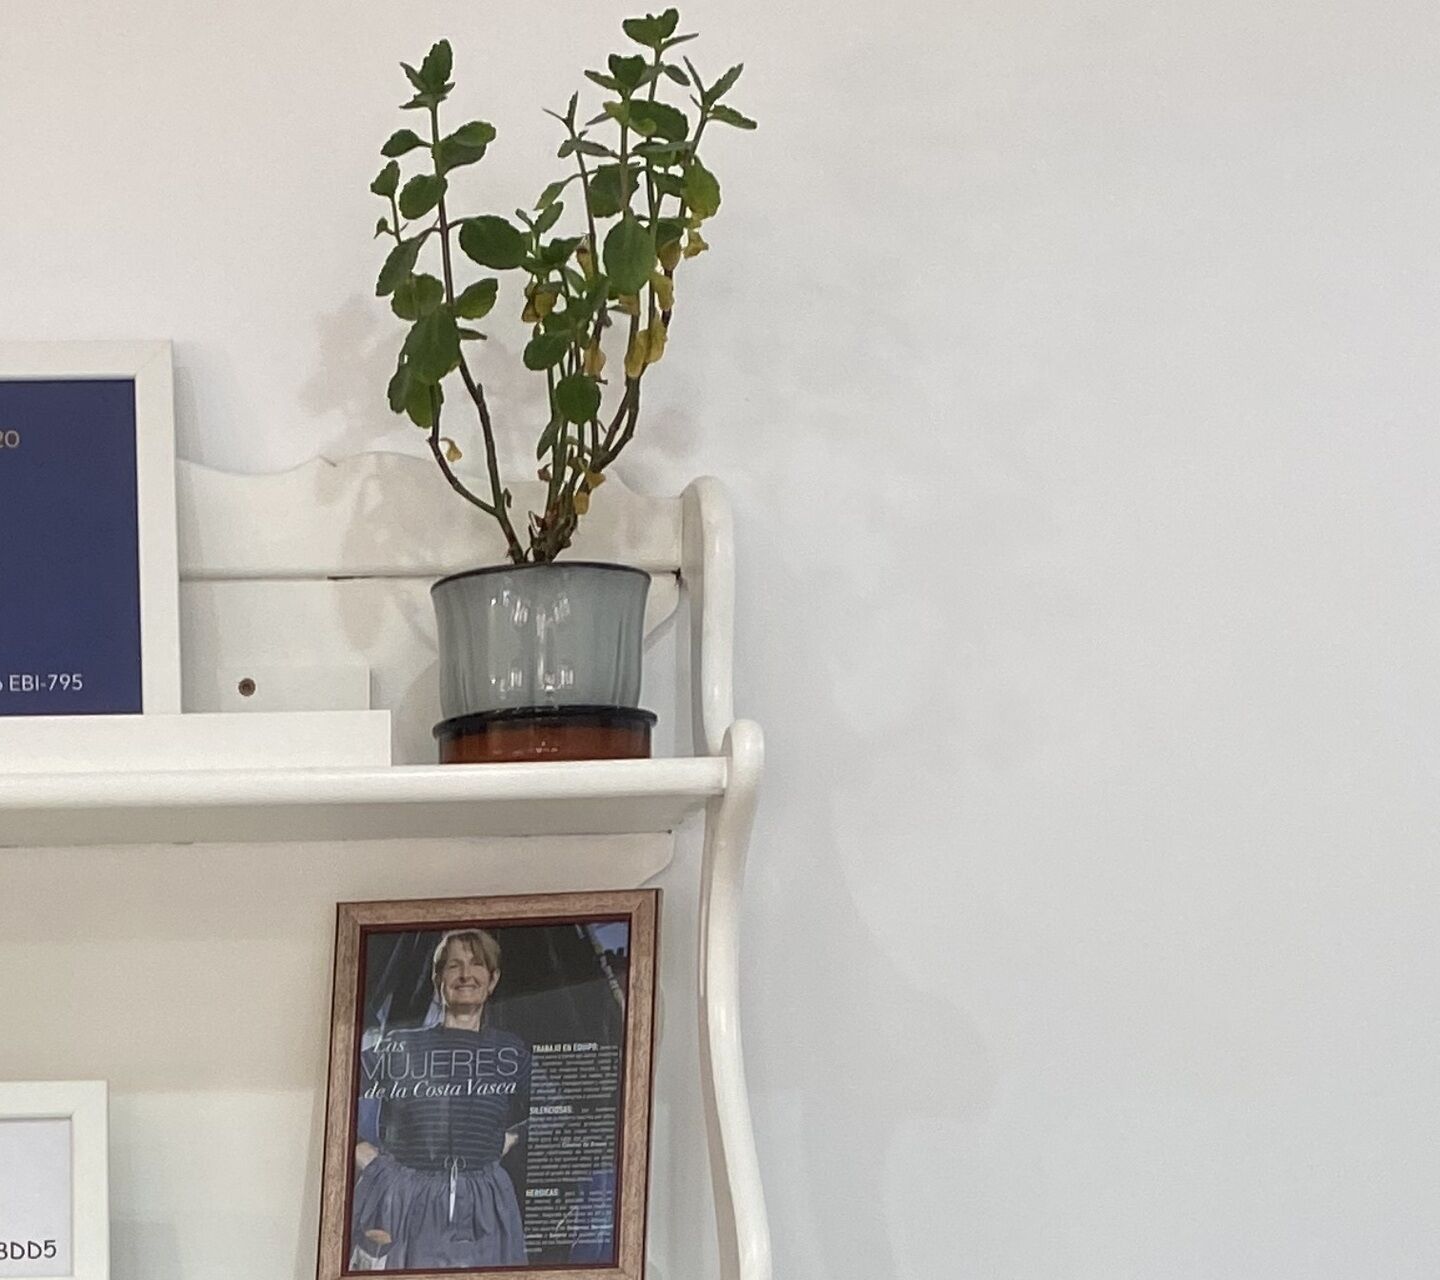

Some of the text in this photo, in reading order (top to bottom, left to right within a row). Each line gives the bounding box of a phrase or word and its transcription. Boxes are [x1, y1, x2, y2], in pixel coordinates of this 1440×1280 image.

[9, 674, 84, 693] EBI-795
[372, 1037, 407, 1054] Las
[532, 1043, 562, 1053] TRABAJO
[563, 1043, 572, 1052] EN
[361, 1046, 520, 1081] MUJERES
[364, 1077, 517, 1099] de la Costa Vasca
